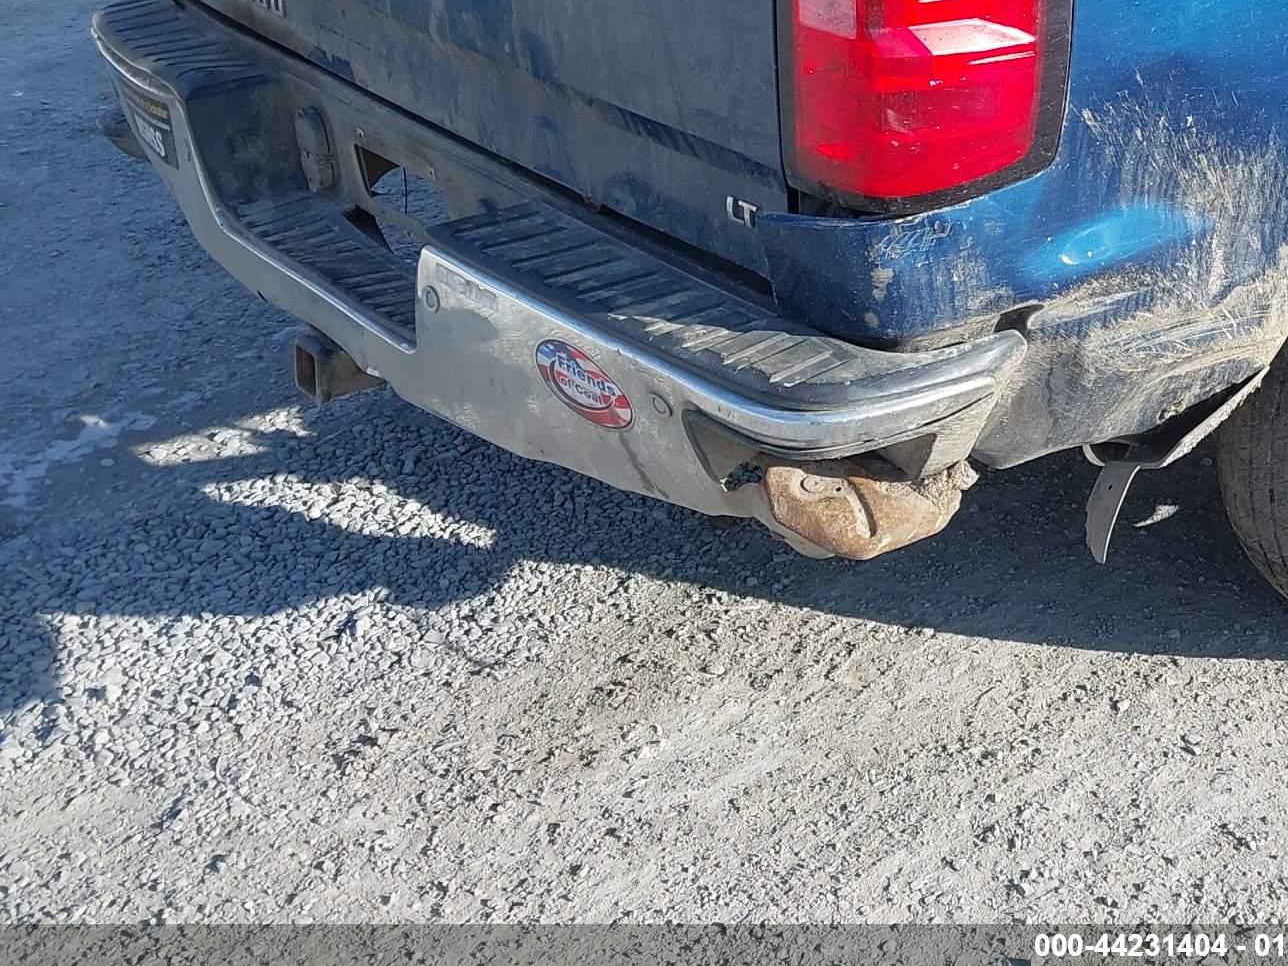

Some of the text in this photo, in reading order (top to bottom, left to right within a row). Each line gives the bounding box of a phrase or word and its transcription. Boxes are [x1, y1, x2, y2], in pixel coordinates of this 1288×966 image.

[726, 195, 758, 228] LT
[556, 354, 617, 398] Friends
[575, 383, 604, 405] Coal
